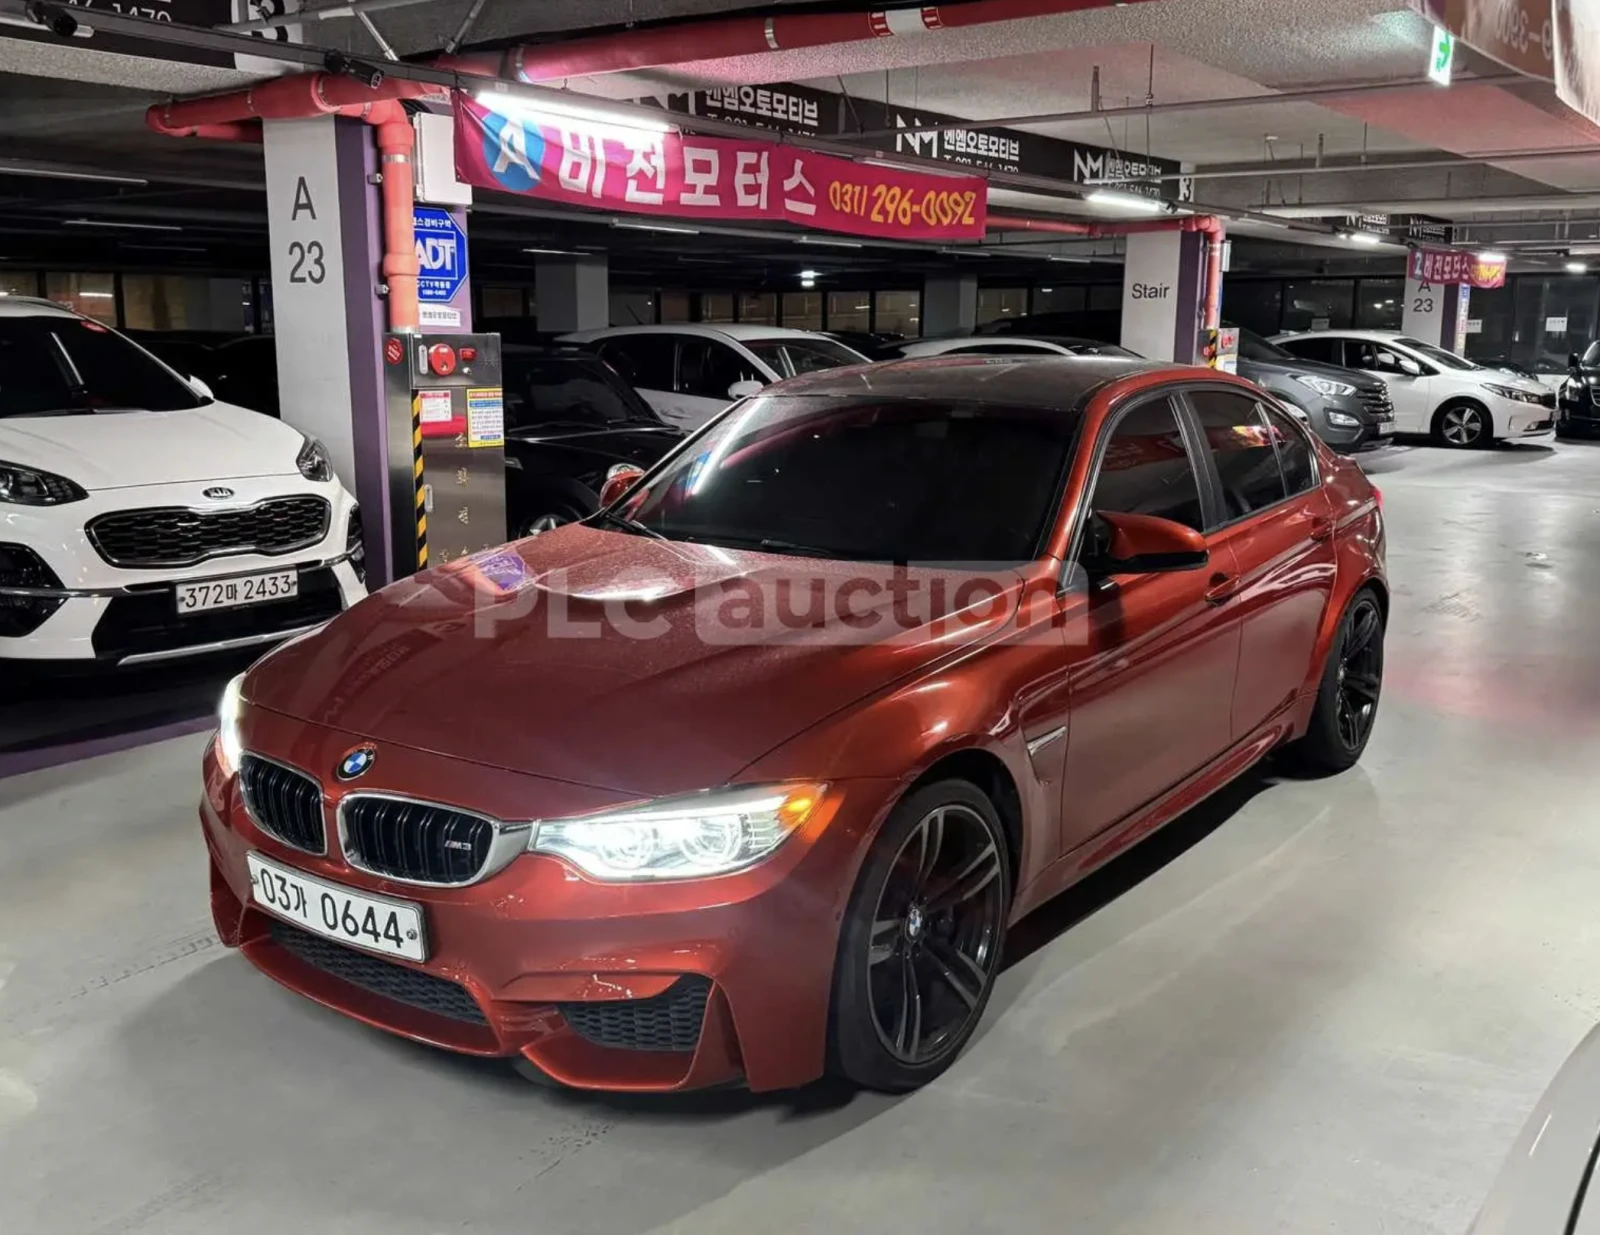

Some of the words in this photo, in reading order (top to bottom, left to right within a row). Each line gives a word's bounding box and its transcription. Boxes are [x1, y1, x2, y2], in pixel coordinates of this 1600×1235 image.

[292, 176, 317, 221] A
[870, 184, 977, 226] 296-0092
[289, 241, 326, 284] 23
[414, 237, 456, 270] ADT
[1131, 283, 1170, 299] Stair
[1413, 298, 1434, 313] 23
[185, 584, 238, 608] 372마
[243, 574, 292, 600] 2433
[260, 868, 308, 919] 03가
[321, 892, 404, 949] 0644
